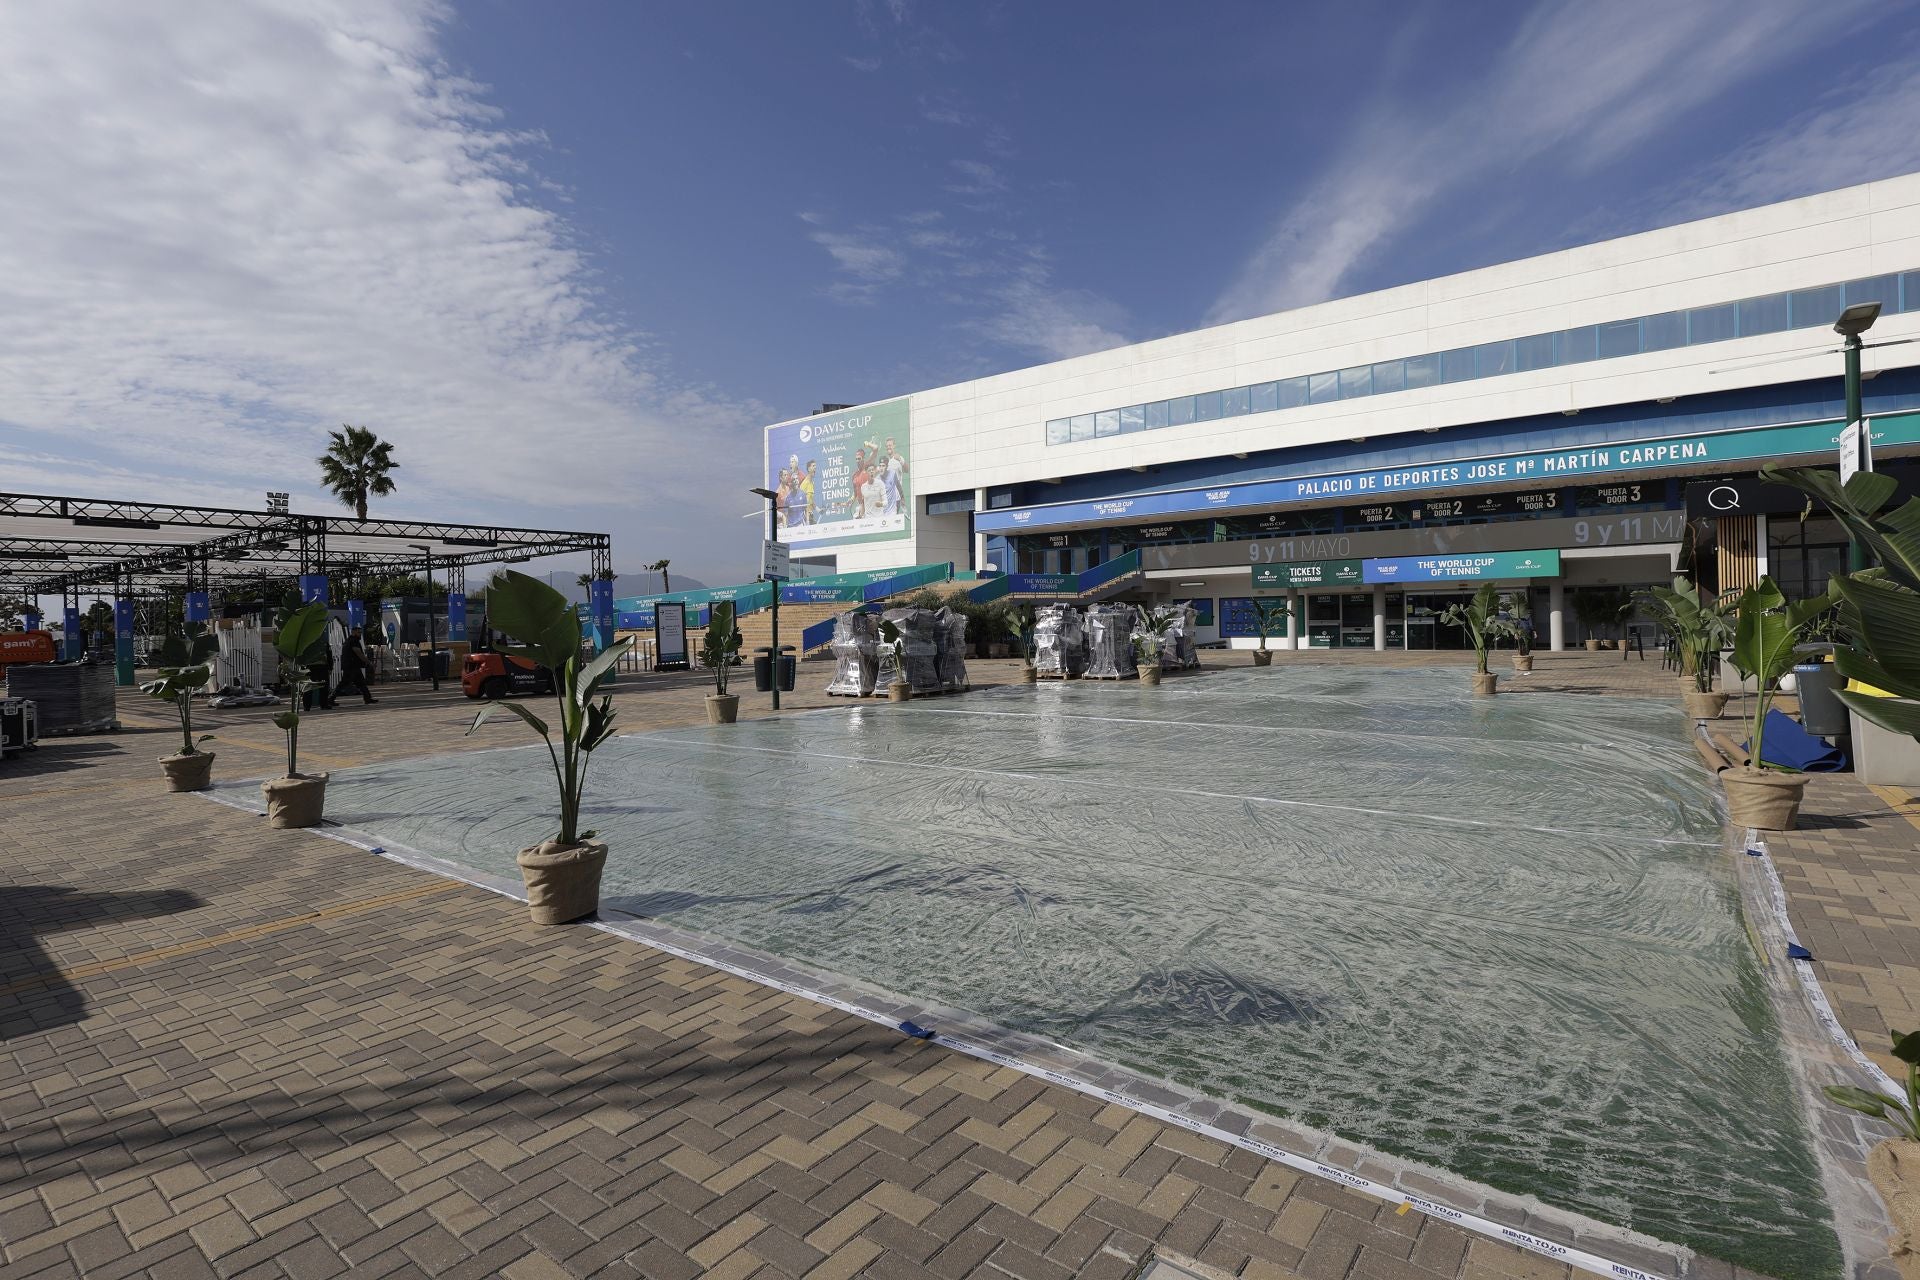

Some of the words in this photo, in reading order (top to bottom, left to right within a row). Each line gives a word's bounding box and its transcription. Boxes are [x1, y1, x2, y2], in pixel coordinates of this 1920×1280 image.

[814, 420, 845, 437] DAVIS
[847, 415, 872, 429] CUP
[827, 456, 844, 467] THE
[821, 466, 850, 479] WORLD
[1297, 478, 1352, 496] PALACIO
[1359, 476, 1376, 490] DE
[1384, 467, 1459, 488] DEPORTES
[1467, 463, 1507, 479] JOSE
[1516, 459, 1535, 474] Mª
[1544, 450, 1609, 472] MARTÍN
[1620, 442, 1708, 464] CARPENA
[822, 478, 838, 490] CUP
[838, 476, 850, 487] OF
[822, 488, 850, 501] TENNIS
[1516, 494, 1544, 504] PUERTA
[1598, 488, 1628, 497] PUERTA
[1606, 496, 1628, 504] DOOR
[1630, 485, 1641, 502] 3
[1426, 502, 1451, 510] PUERTA
[1524, 502, 1544, 510] DOOR
[1546, 492, 1556, 508] 3
[1360, 508, 1382, 516] PUERTA
[1366, 514, 1382, 522] DOOR
[1384, 506, 1394, 520] 2
[1454, 500, 1463, 516] 2
[1574, 521, 1590, 543] 9
[1597, 524, 1612, 545] y
[1620, 518, 1641, 540] 11
[1064, 535, 1069, 546] 1
[1249, 544, 1259, 562] 9
[1264, 546, 1275, 564] y
[1280, 541, 1294, 560] 11
[1301, 536, 1350, 558] MAYO
[1418, 560, 1436, 570] THE
[1438, 559, 1472, 568] WORLD
[1474, 558, 1494, 568] CUP
[1290, 566, 1322, 577] TICKETS
[1431, 569, 1442, 577] OF
[1446, 567, 1481, 576] TENNIS
[3, 639, 31, 650] gam
